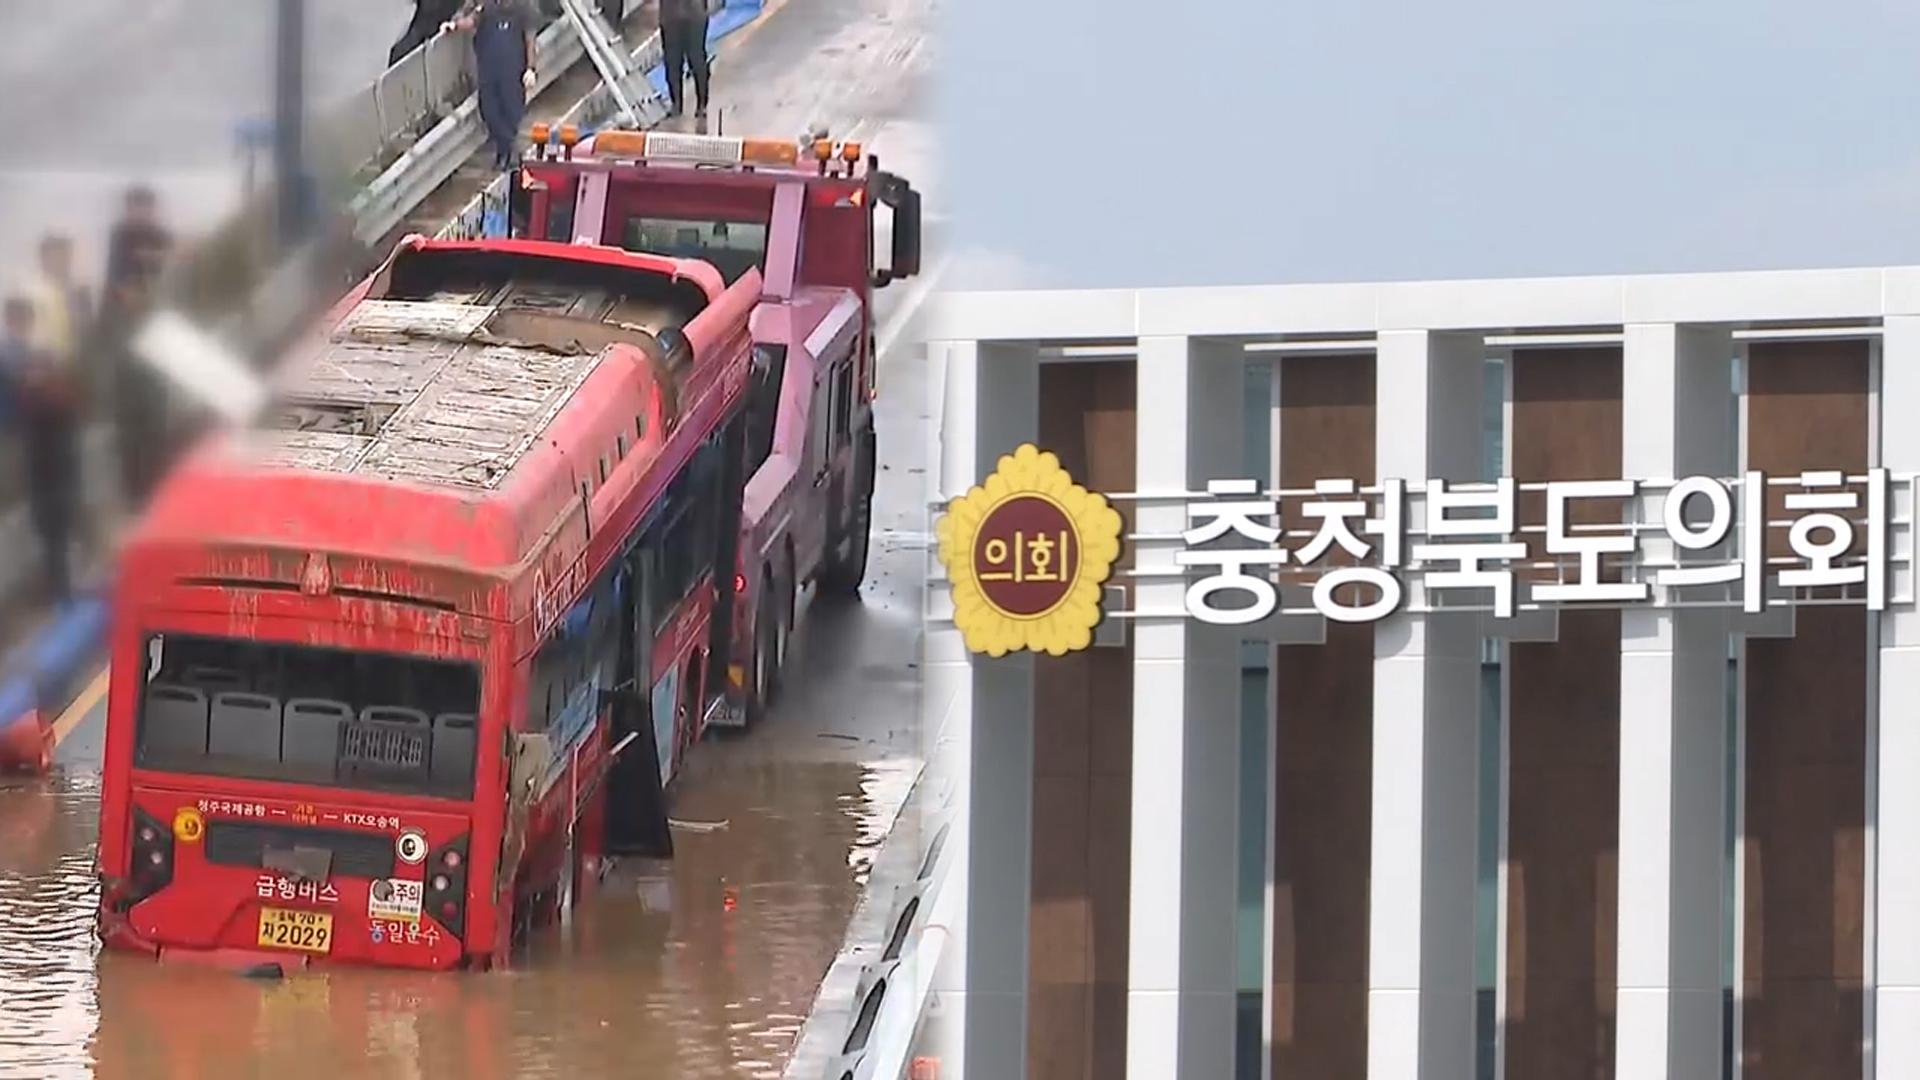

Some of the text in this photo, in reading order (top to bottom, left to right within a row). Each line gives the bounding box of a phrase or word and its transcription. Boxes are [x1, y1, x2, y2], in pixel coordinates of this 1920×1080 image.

[979, 530, 1068, 583] 의회
[1175, 467, 1888, 625] 충청북도의회
[198, 799, 266, 817] 청주국제공항
[343, 813, 400, 829] KTX오송역
[256, 875, 339, 903] 급행버스
[299, 913, 315, 925] 70
[369, 920, 441, 947] 동일운수
